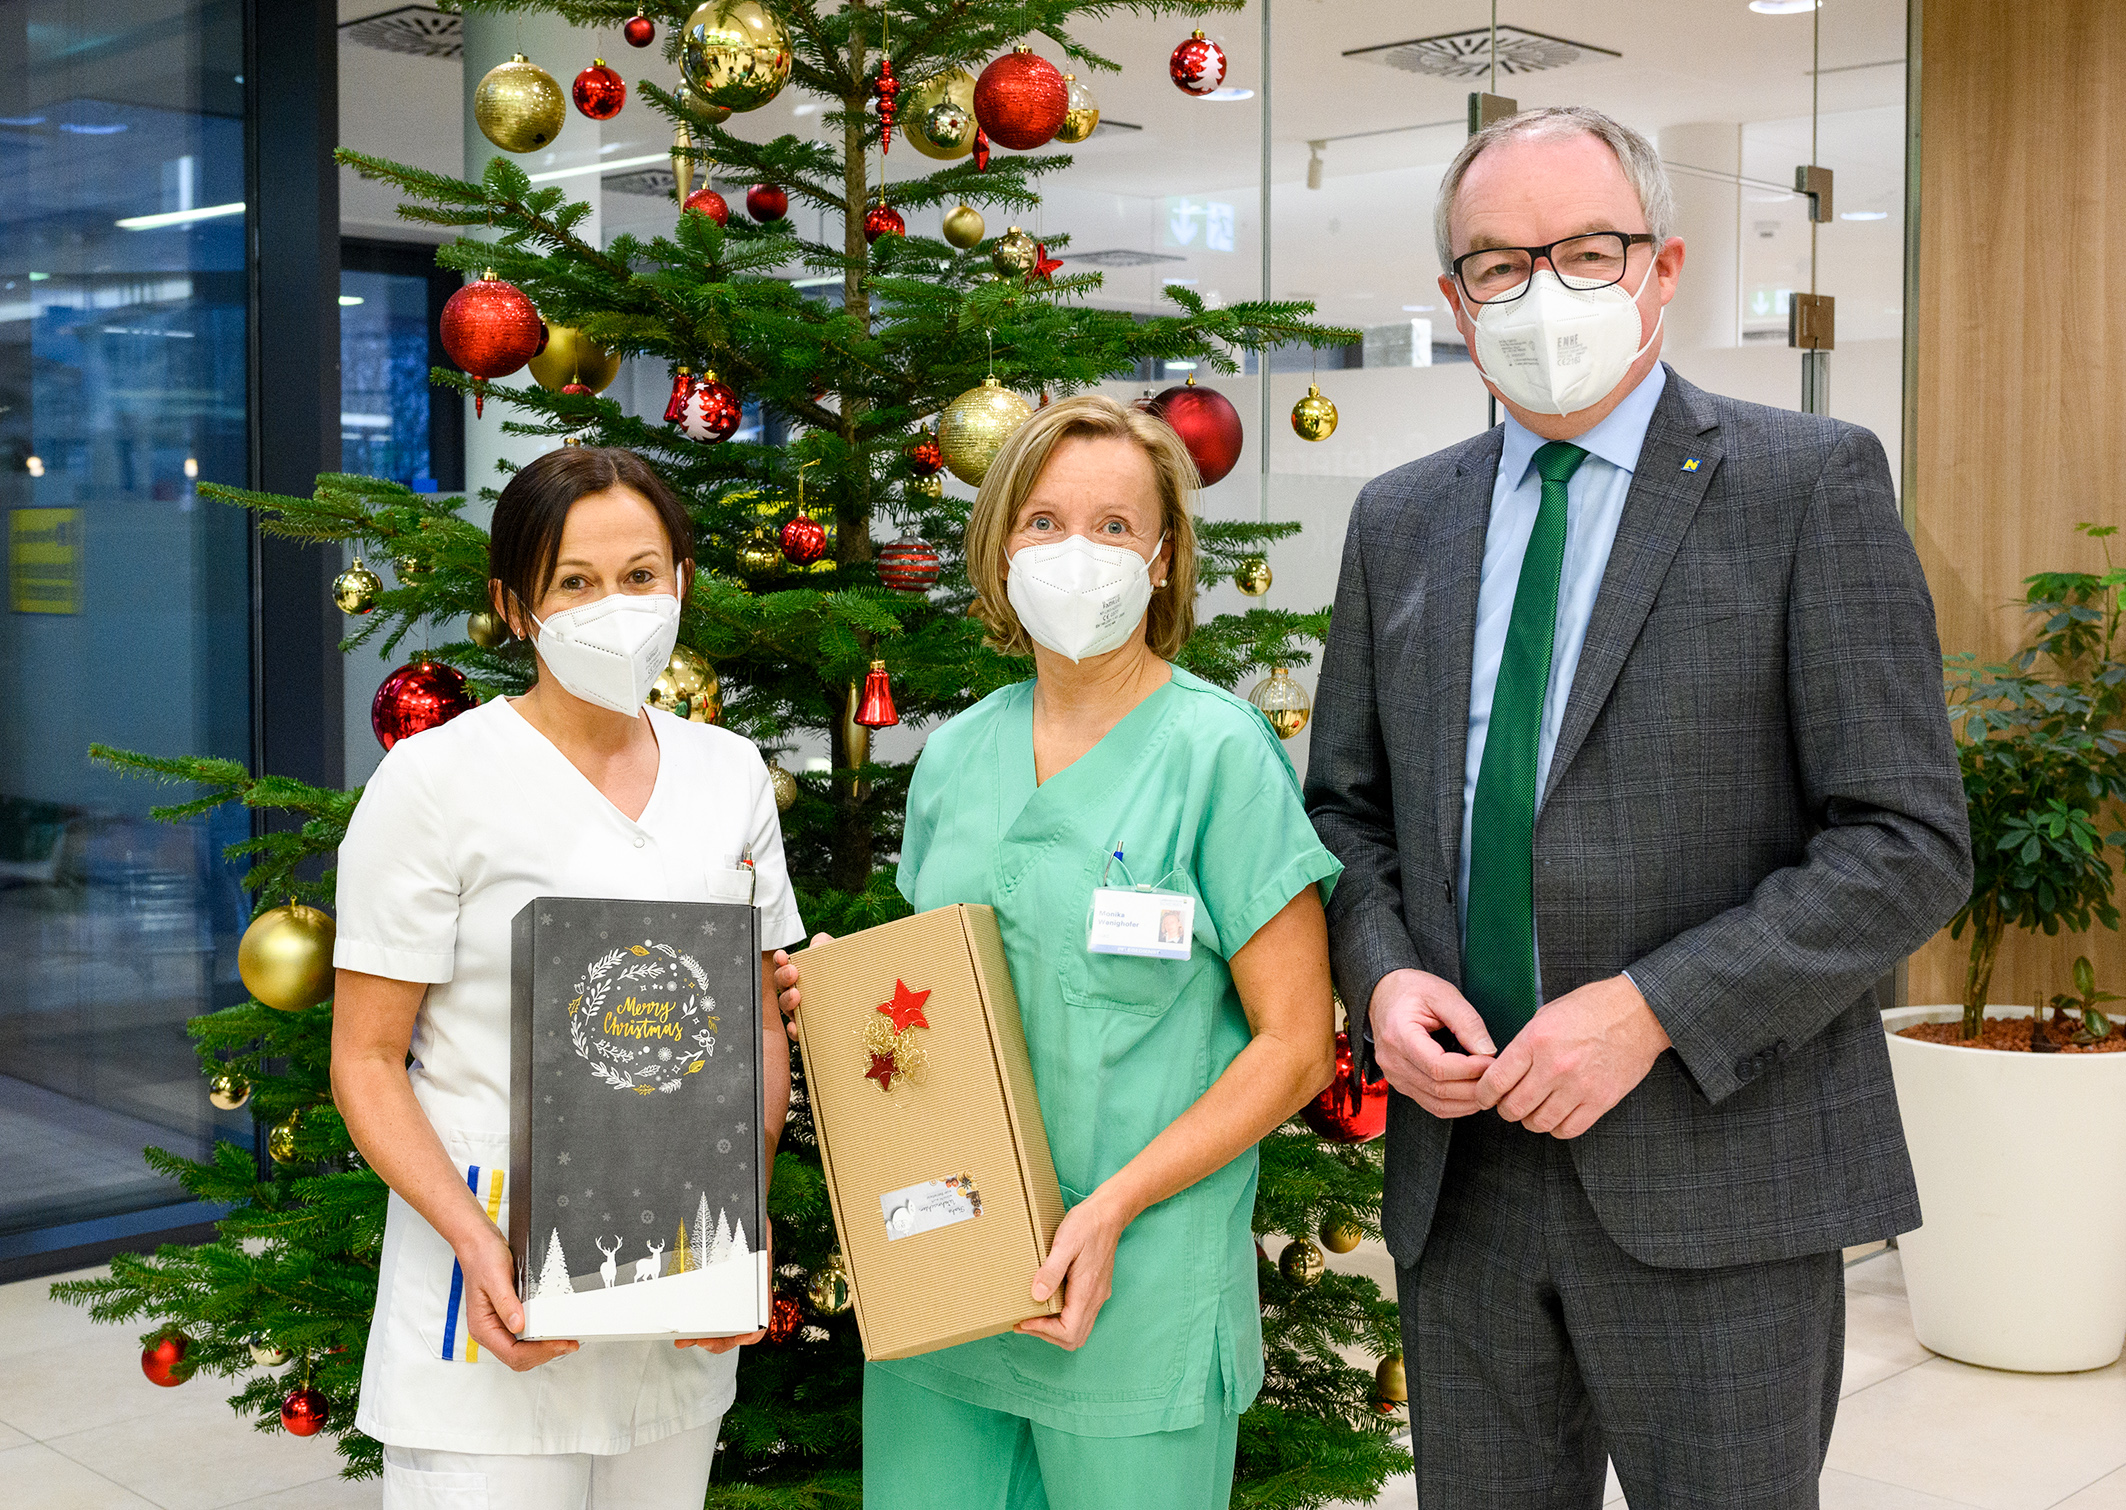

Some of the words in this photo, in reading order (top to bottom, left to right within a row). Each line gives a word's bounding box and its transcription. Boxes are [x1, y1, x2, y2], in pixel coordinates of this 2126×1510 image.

[1099, 910, 1125, 918] Monika
[1098, 919, 1140, 928] Wenighofer
[616, 996, 677, 1024] Merry
[603, 1011, 684, 1042] Christmas
